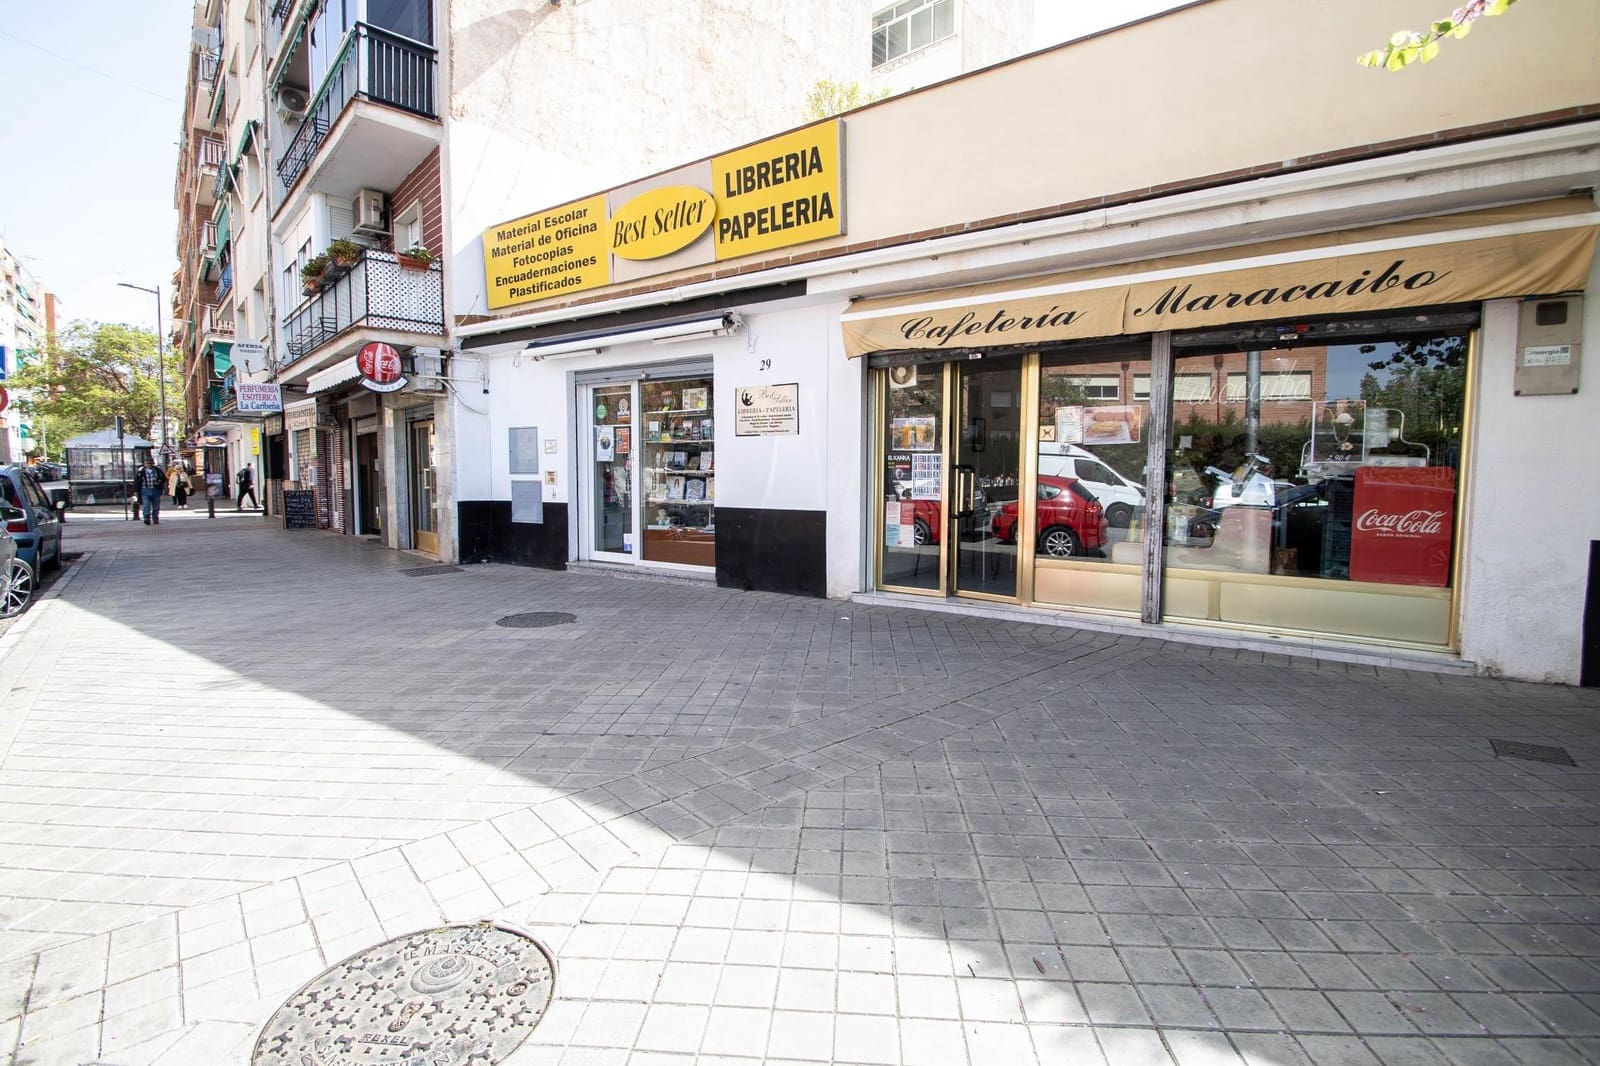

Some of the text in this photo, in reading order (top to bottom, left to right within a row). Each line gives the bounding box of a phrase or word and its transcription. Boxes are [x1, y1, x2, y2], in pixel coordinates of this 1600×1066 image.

[725, 146, 823, 198] LIBRERIA
[497, 208, 589, 243] Material Escolar
[613, 198, 707, 249] Best Seller
[719, 192, 834, 244] PAPELERIA
[491, 222, 598, 258] Material de Oficina
[513, 245, 574, 268] Fotocopias
[495, 255, 597, 287] Encuadernaciones
[509, 275, 582, 298] Plastificados
[900, 258, 1452, 346] Cafetería Maracaibo
[759, 358, 772, 371] 29
[240, 401, 281, 410] La Caribeña
[1356, 508, 1447, 534] Coca-Cola
